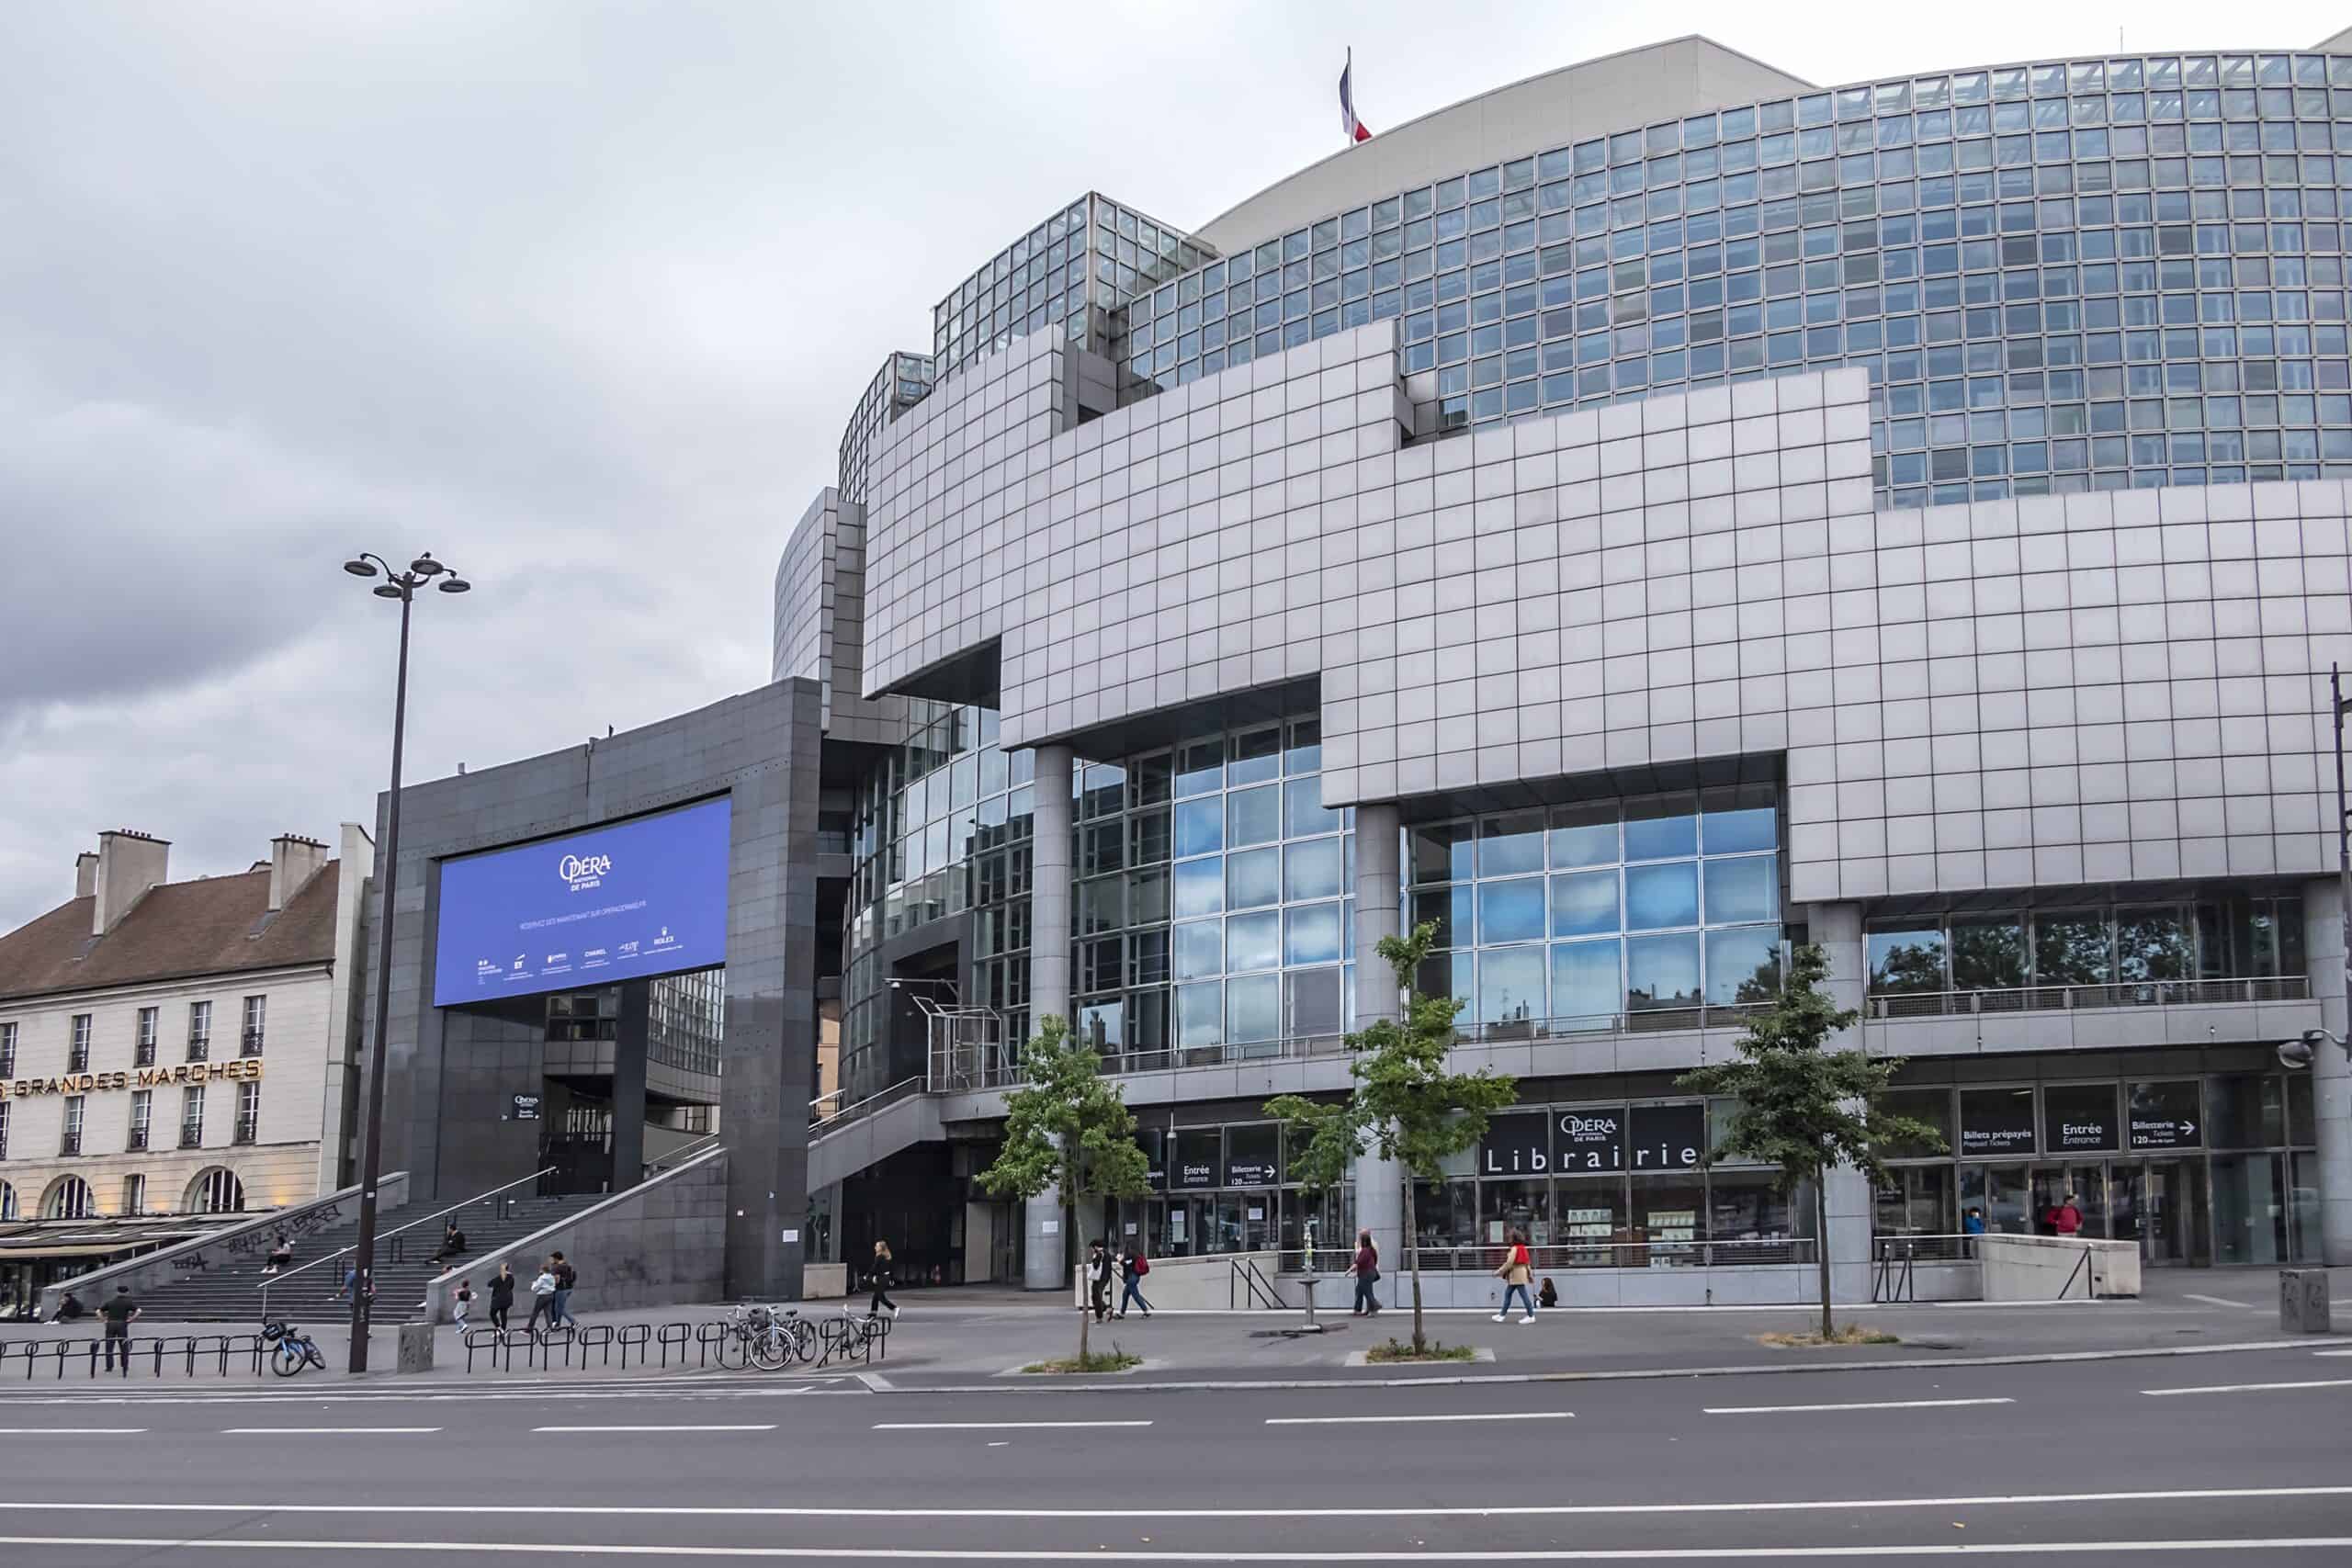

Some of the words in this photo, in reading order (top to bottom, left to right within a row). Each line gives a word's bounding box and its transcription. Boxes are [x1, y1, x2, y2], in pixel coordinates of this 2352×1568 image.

[560, 854, 612, 883] OPÉRA
[582, 880, 601, 889] PARIS
[654, 936, 674, 945] ROLEX
[15, 1071, 127, 1097] GRANDES
[138, 1059, 261, 1084] MARCHES
[2063, 1122, 2103, 1135] Entrée
[2132, 1121, 2175, 1130] Billetterie
[1962, 1131, 1990, 1140] Billets
[1992, 1128, 2032, 1140] prépayés
[2063, 1135, 2102, 1145] Entrance
[2132, 1135, 2148, 1145] 120
[1487, 1143, 1698, 1172] Librairie
[1183, 1165, 1210, 1175] Entrée
[1231, 1166, 1262, 1174] Billetterie
